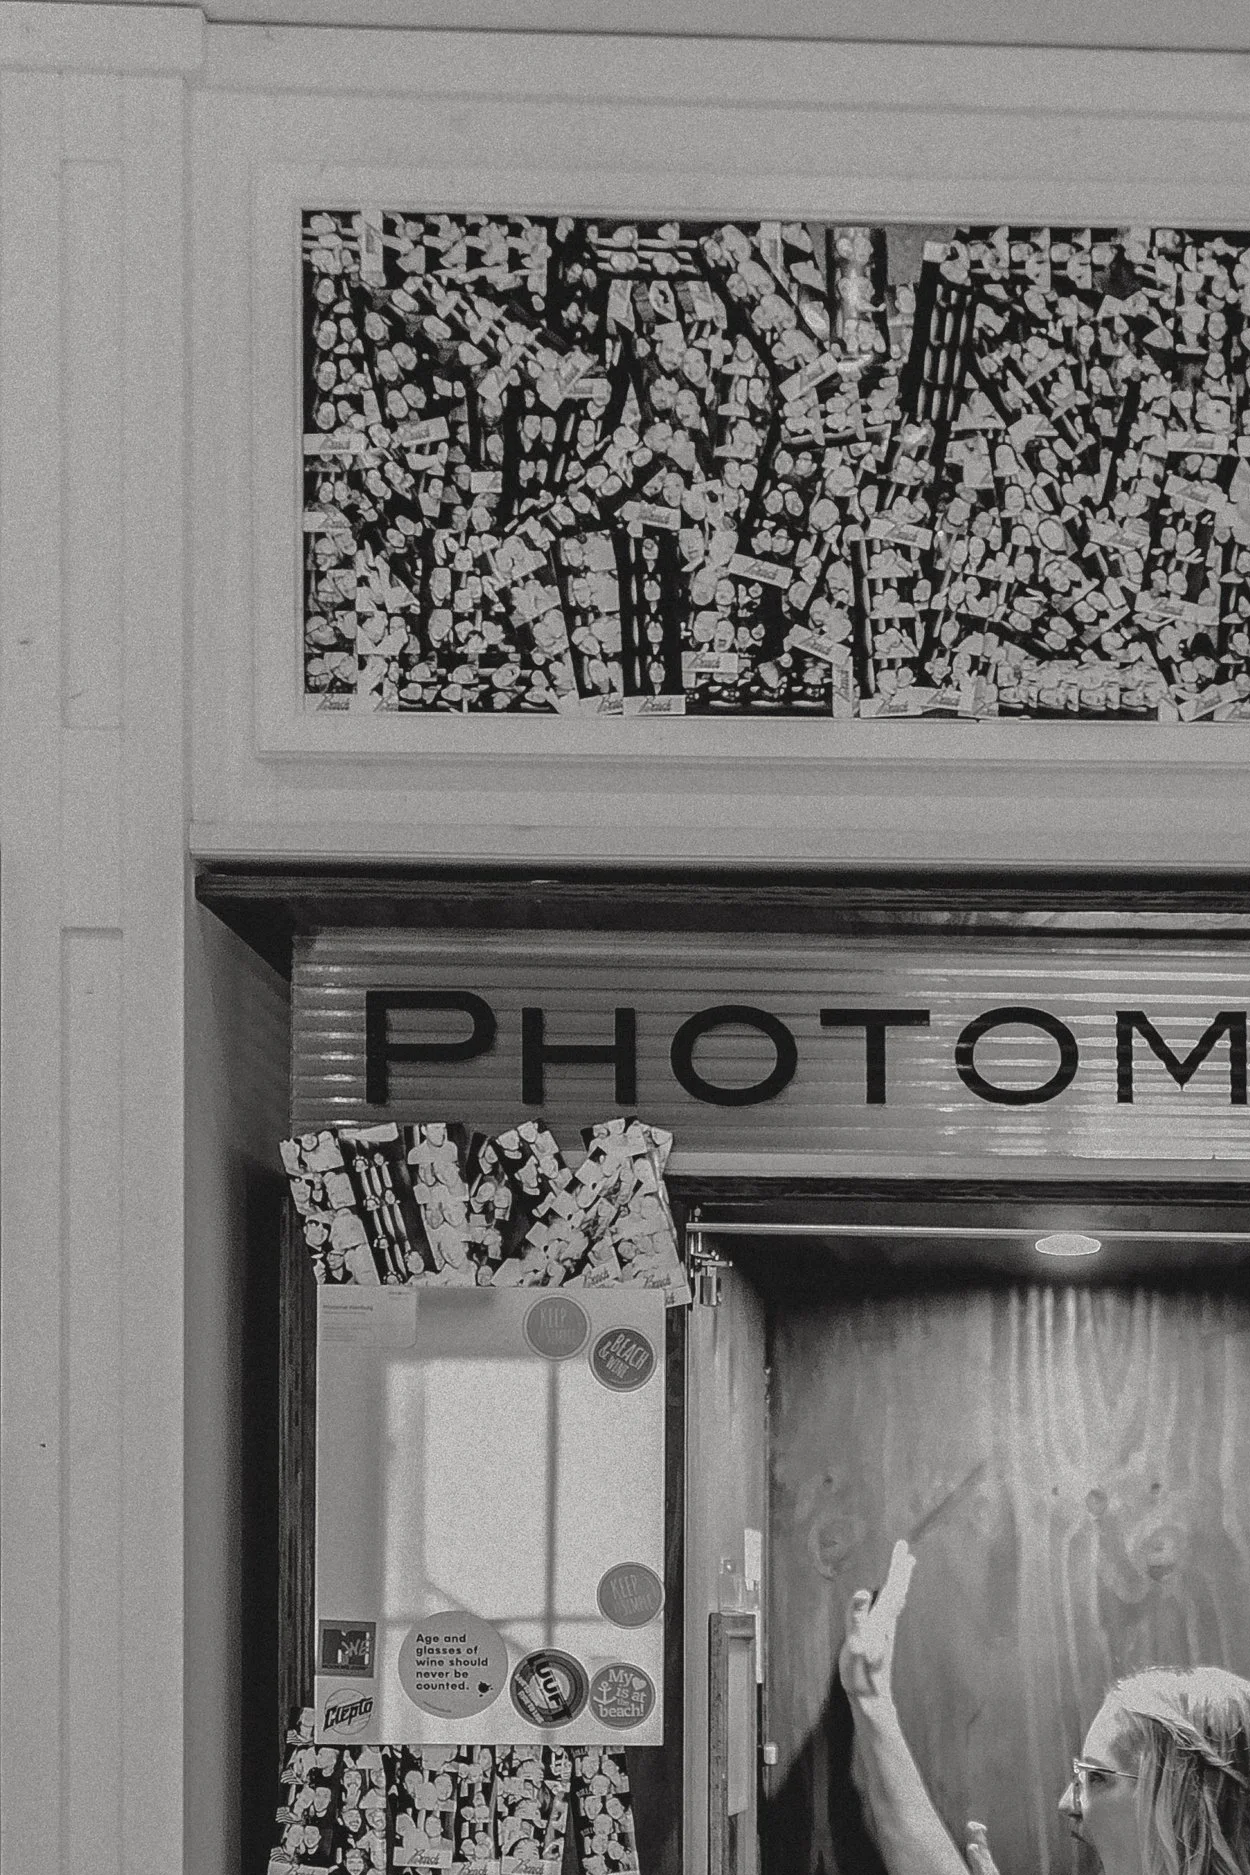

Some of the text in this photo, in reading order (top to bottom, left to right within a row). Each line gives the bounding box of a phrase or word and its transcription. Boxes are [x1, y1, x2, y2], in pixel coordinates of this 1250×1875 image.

[609, 1333, 650, 1370] BEACH
[610, 1574, 638, 1600] KEEP
[416, 1634, 467, 1646] Age and
[415, 1645, 478, 1657] glasses of
[415, 1657, 488, 1667] wine should
[415, 1670, 469, 1679] never be
[608, 1669, 633, 1687] My
[415, 1681, 470, 1691] counted.
[616, 1684, 647, 1704] is at
[598, 1703, 645, 1718] beach!
